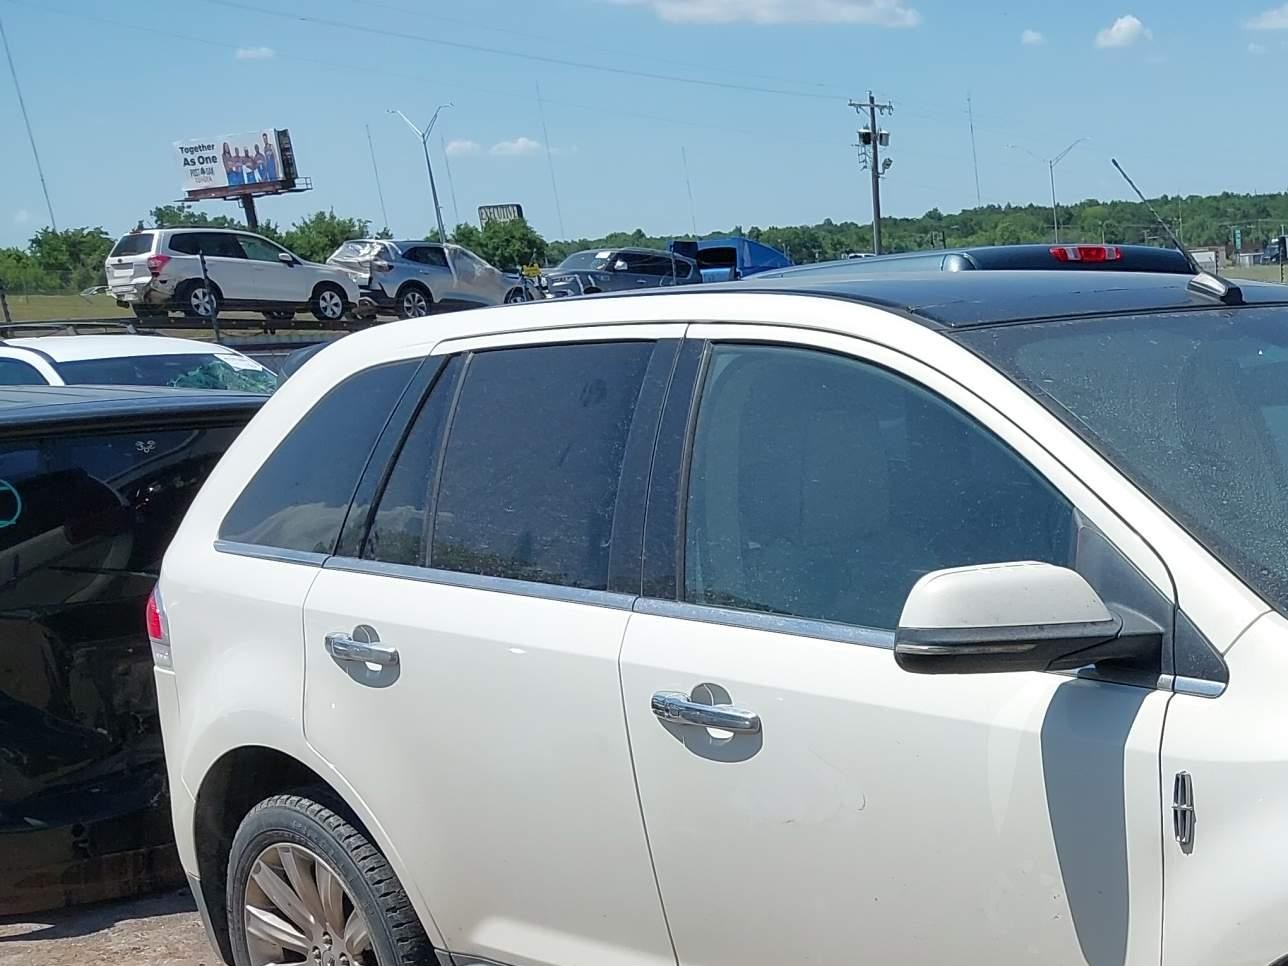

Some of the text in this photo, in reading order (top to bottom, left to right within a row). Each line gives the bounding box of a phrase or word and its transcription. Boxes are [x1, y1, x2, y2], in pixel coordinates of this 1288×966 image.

[179, 144, 214, 154] Together
[183, 156, 217, 167] As One
